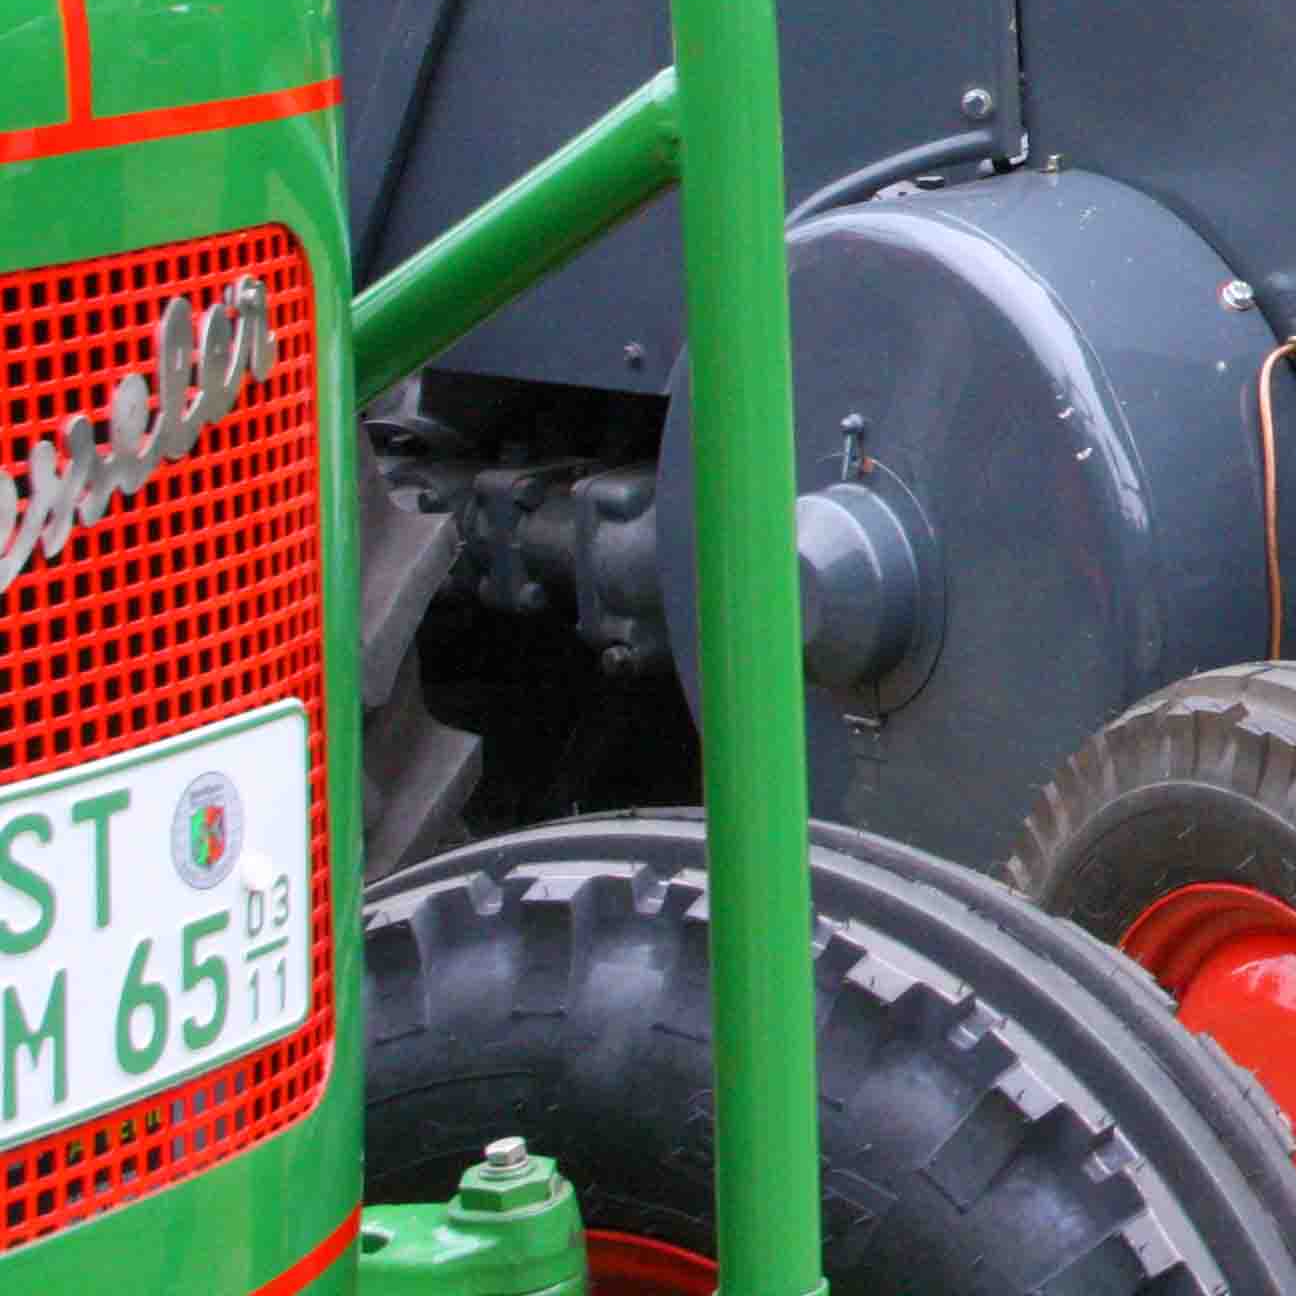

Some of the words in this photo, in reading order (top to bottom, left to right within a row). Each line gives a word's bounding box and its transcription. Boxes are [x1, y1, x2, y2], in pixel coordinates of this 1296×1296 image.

[0, 788, 131, 956] ST
[114, 909, 231, 1076] 65
[249, 956, 288, 1024] 11
